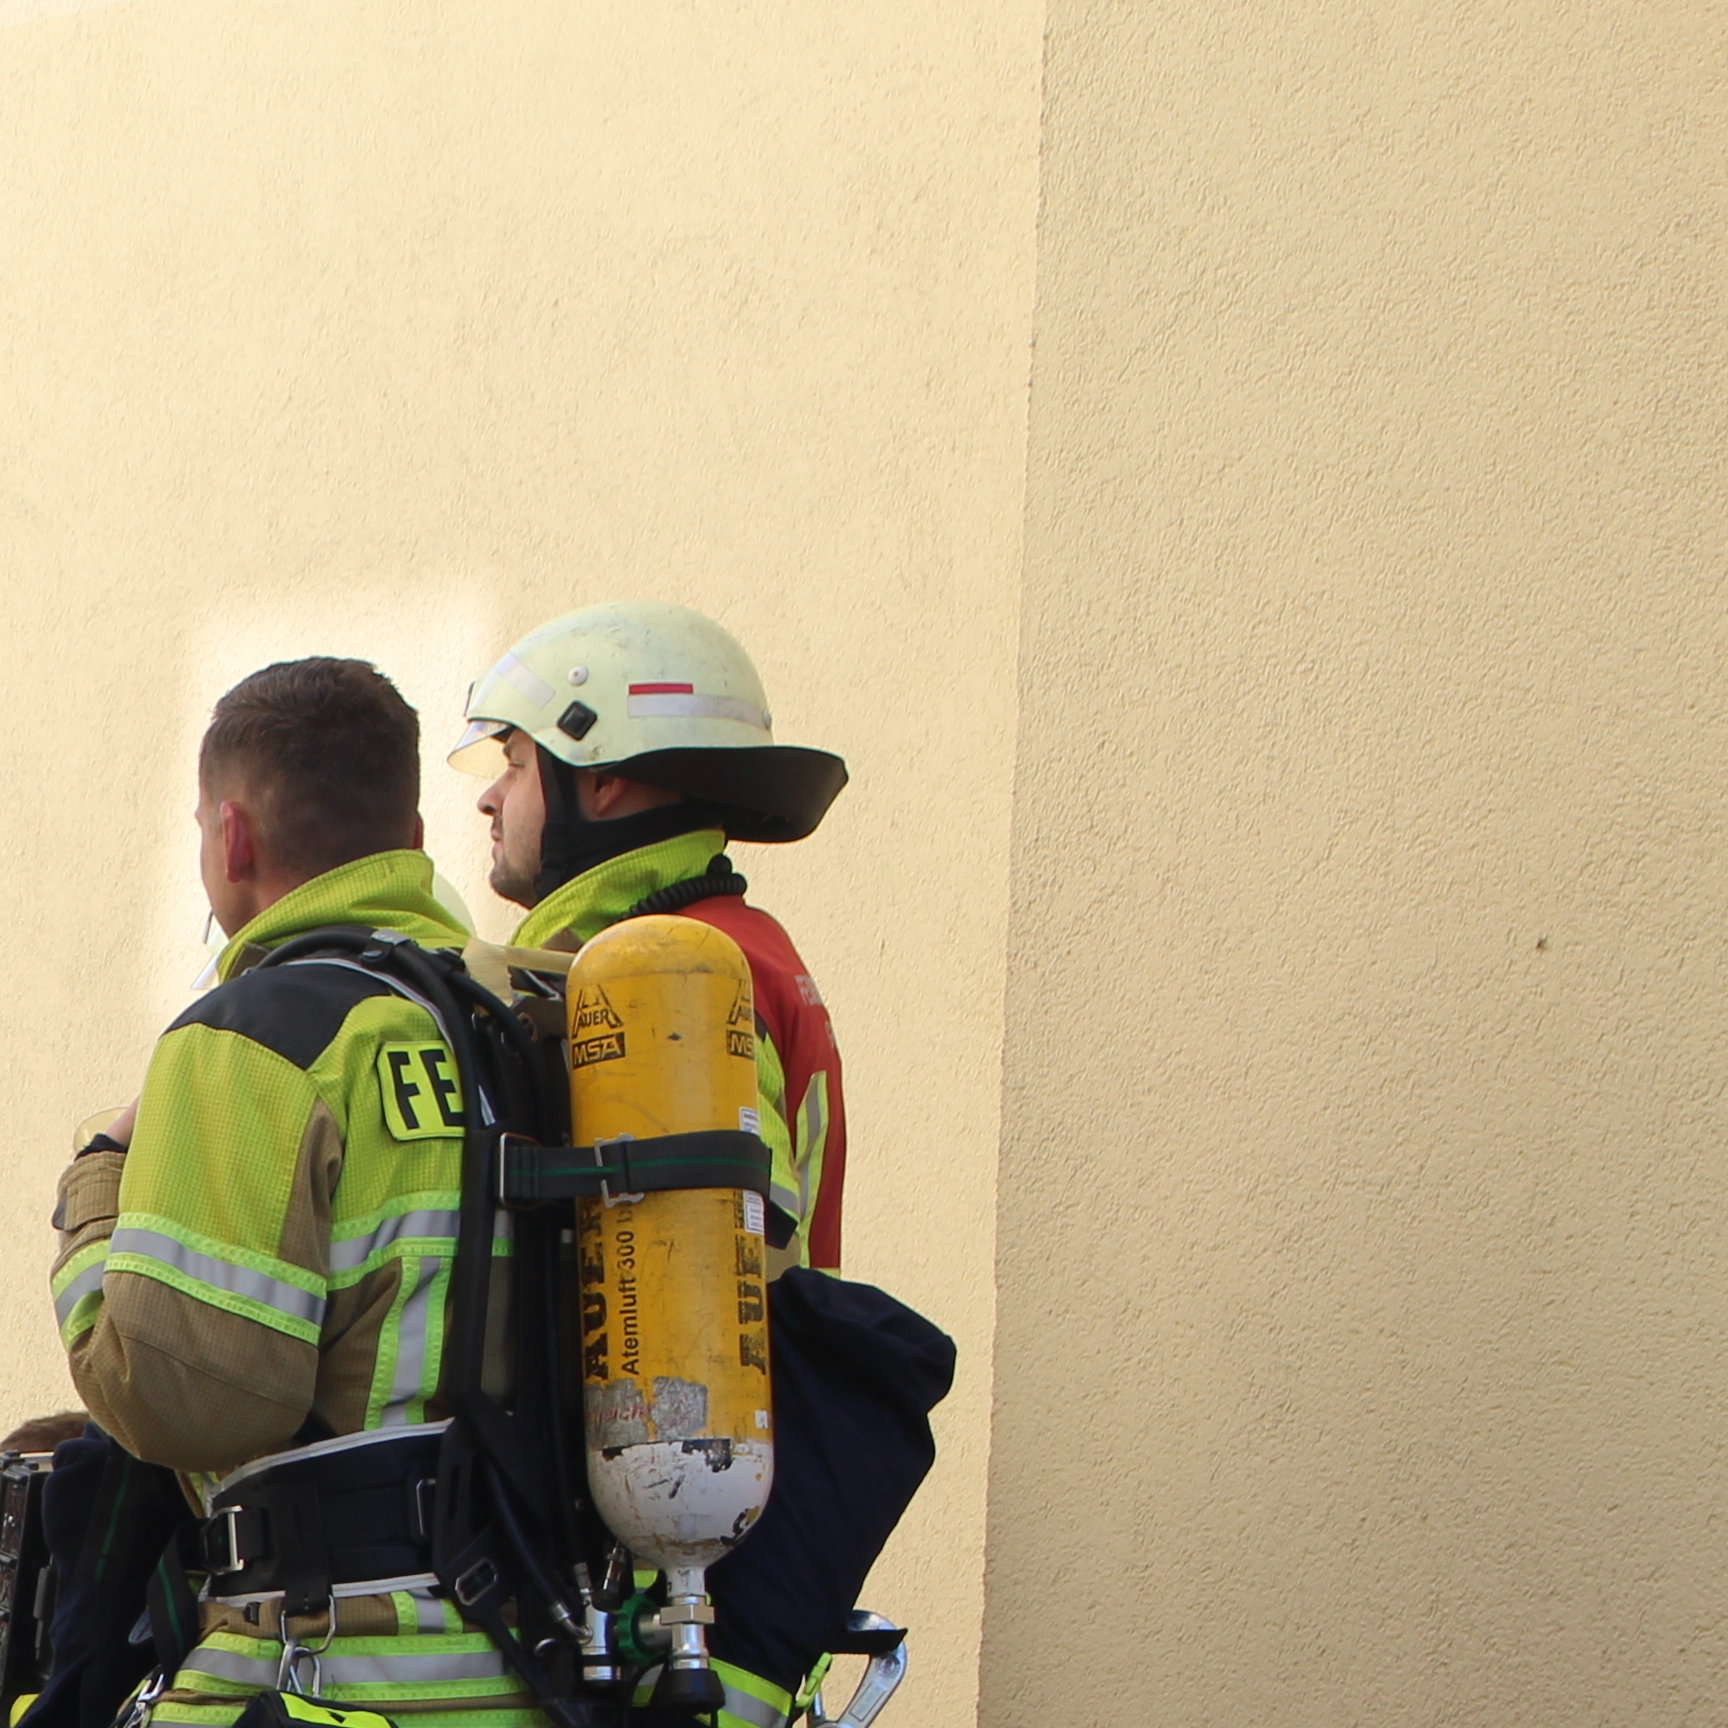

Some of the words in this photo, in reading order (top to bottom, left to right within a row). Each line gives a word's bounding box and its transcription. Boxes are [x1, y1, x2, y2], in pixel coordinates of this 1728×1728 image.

[573, 1034, 623, 1067] MSA
[387, 1049, 464, 1130] FE
[616, 1230, 636, 1270] 300
[618, 1275, 640, 1376] Atemluft
